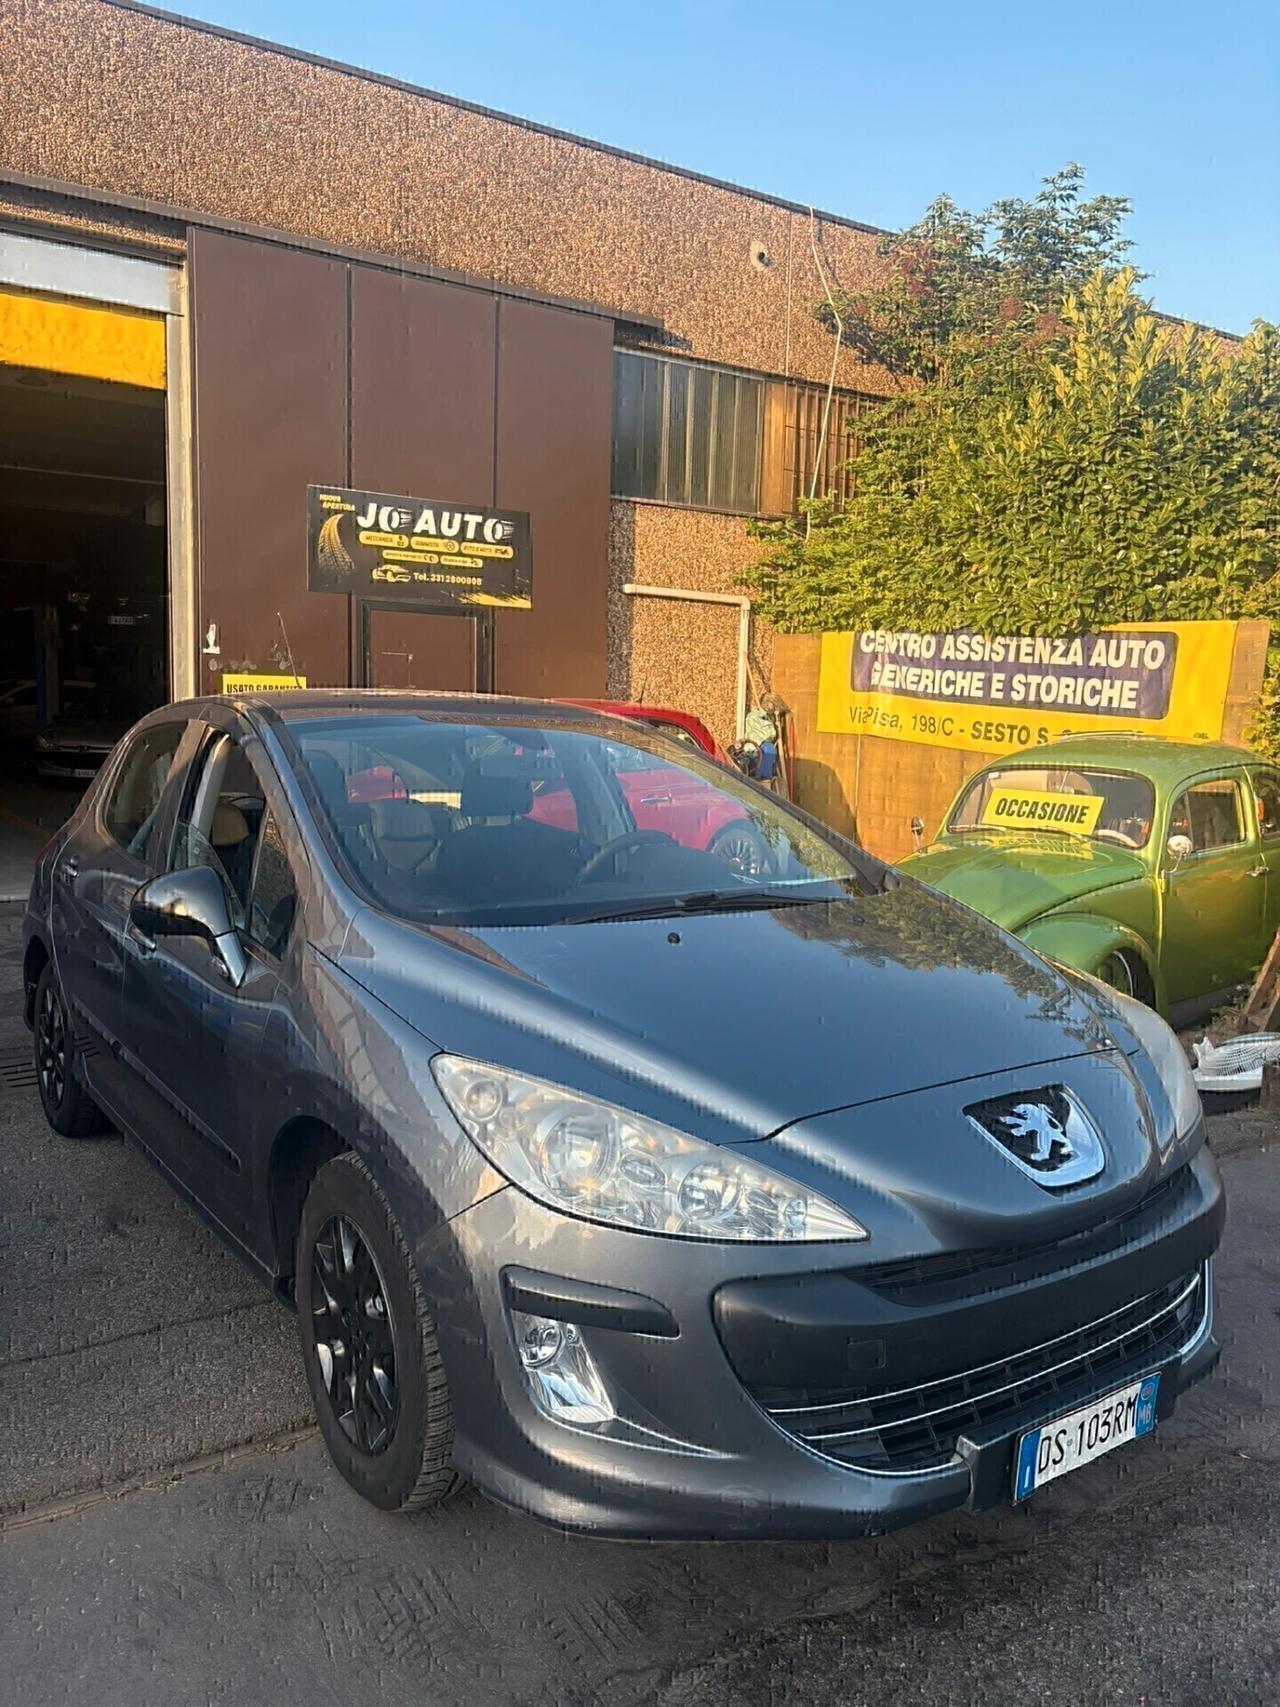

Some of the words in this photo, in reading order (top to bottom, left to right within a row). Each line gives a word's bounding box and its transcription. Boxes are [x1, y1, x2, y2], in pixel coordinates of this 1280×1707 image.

[356, 502, 400, 532] JO
[413, 509, 504, 543] AUTO
[413, 572, 430, 582] Tel.
[860, 630, 936, 659] CENTRO
[941, 634, 1083, 665] ASSISTENZA
[1089, 639, 1165, 670] AUTO
[226, 683, 255, 694] USATO
[871, 662, 984, 698] GENERICHE
[990, 672, 1005, 699] E
[1010, 674, 1139, 709] STORICHE
[971, 720, 1031, 745] SESTO
[995, 798, 1089, 823] OCCASIONE
